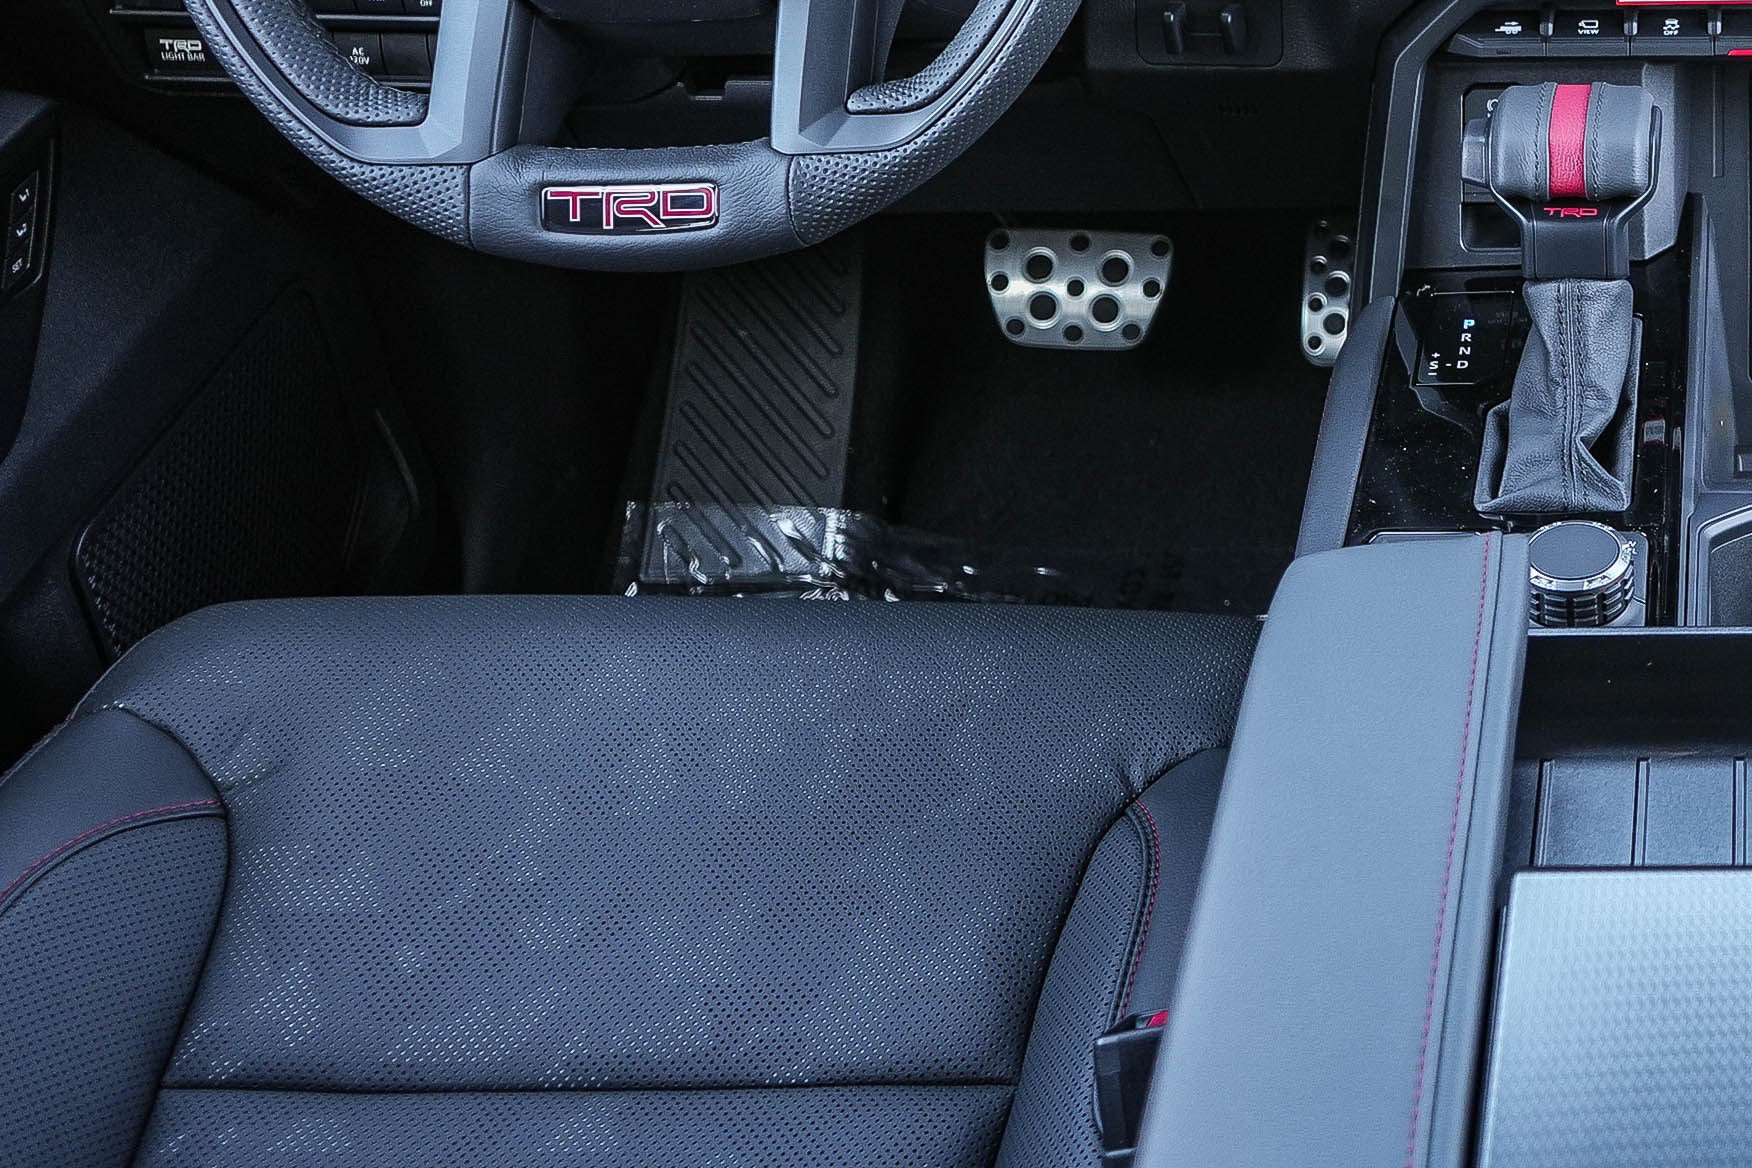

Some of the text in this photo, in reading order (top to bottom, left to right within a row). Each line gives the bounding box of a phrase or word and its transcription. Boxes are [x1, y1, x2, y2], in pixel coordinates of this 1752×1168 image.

[160, 39, 202, 53] TRD
[352, 47, 365, 56] AC
[161, 52, 205, 62] LIGHT BAR
[546, 183, 718, 230] TRD
[1543, 207, 1598, 218] TRD
[1463, 319, 1476, 330] P
[1460, 333, 1472, 342] R
[1458, 346, 1471, 355] N
[1429, 360, 1469, 370] S D
